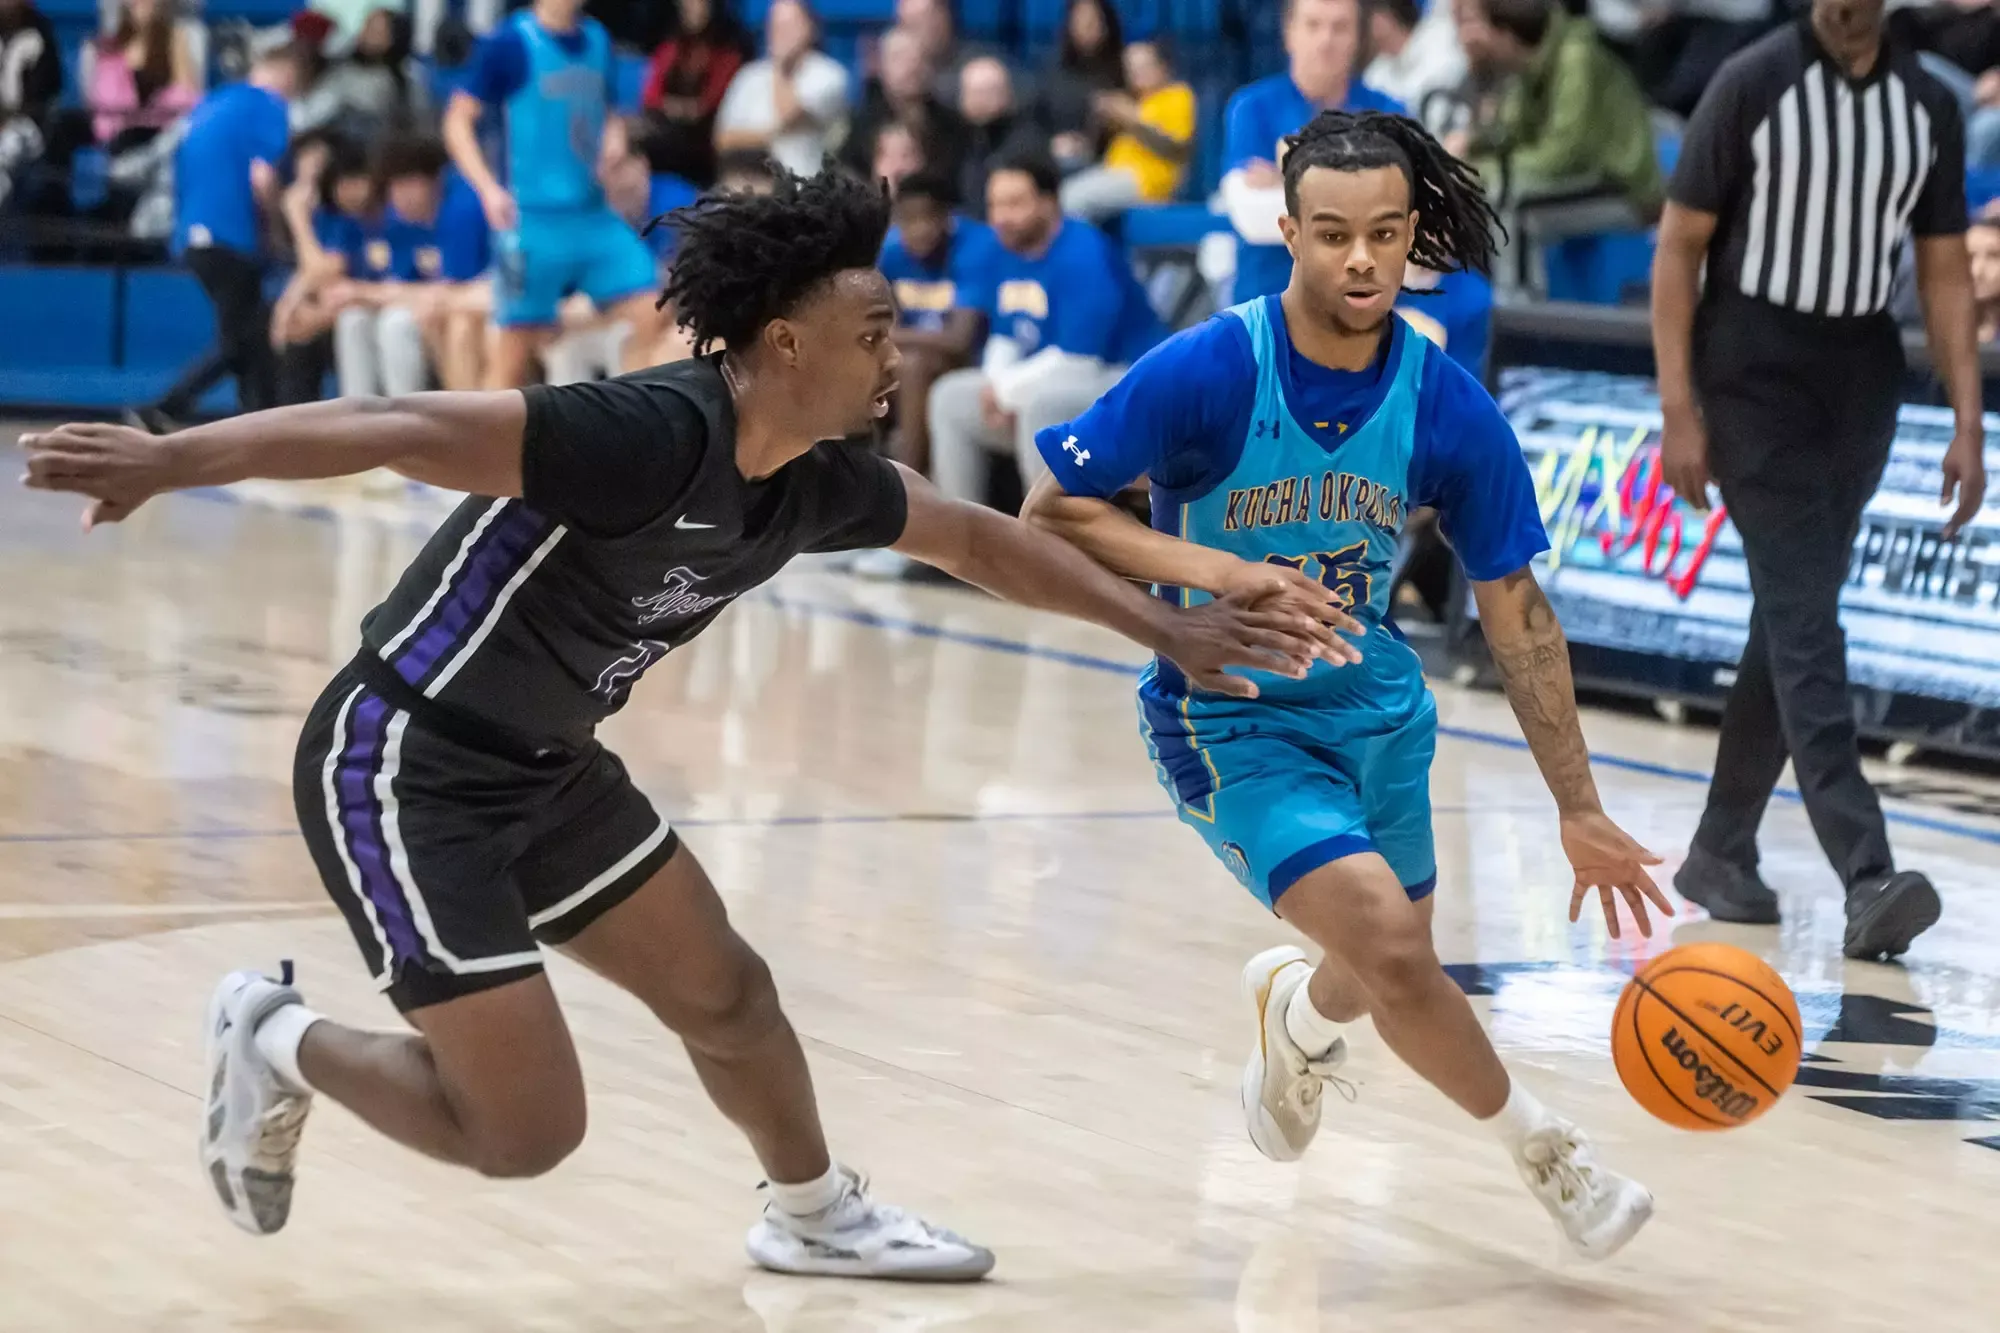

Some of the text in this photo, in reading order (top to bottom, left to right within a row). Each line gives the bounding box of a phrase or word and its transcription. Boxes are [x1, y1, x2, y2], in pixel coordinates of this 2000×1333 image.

[1224, 475, 1311, 531] KUCHA
[1264, 540, 1373, 631] 5
[1661, 1027, 1758, 1119] Wilson
